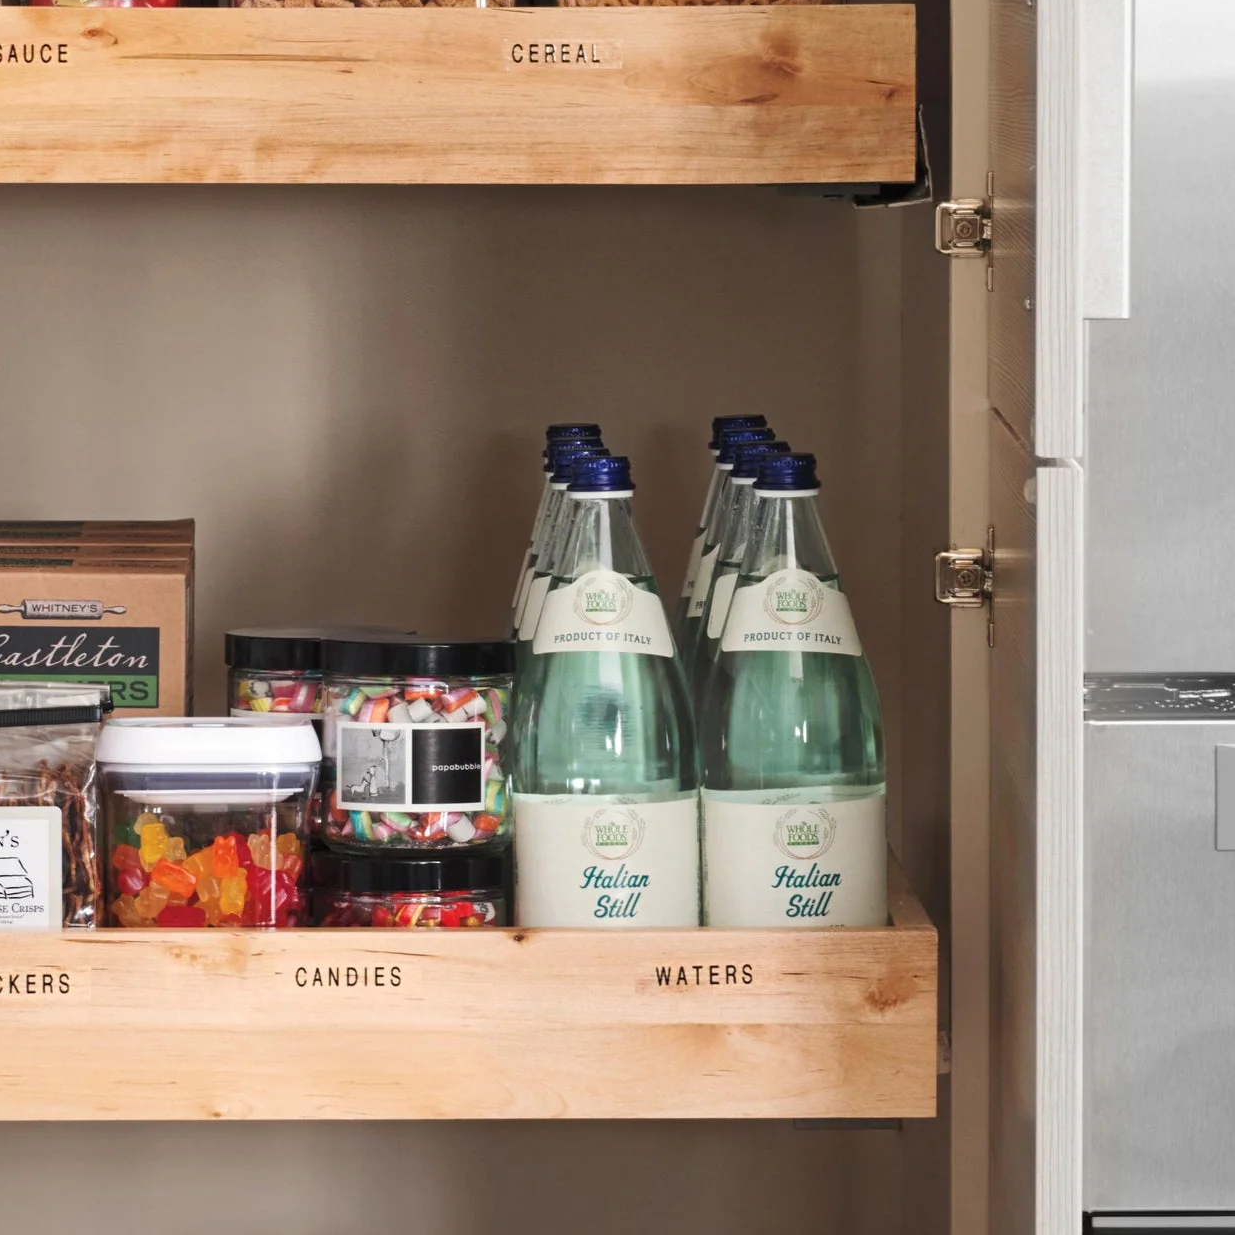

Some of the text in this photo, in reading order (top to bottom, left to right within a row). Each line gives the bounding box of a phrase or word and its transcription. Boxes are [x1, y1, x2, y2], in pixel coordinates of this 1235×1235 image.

[511, 43, 601, 63] CEREAL
[32, 604, 99, 614] WHITNEY'S
[554, 632, 652, 645] PRODUCT OF ITALY
[743, 632, 842, 645] PRODUCT OF ITALY
[432, 763, 482, 772] papabubble
[579, 863, 651, 890] Italian
[771, 863, 843, 890] Italian
[594, 892, 642, 918] Still
[785, 891, 834, 918] Still
[295, 967, 402, 987] CANDIES
[656, 964, 754, 986] WATERS
